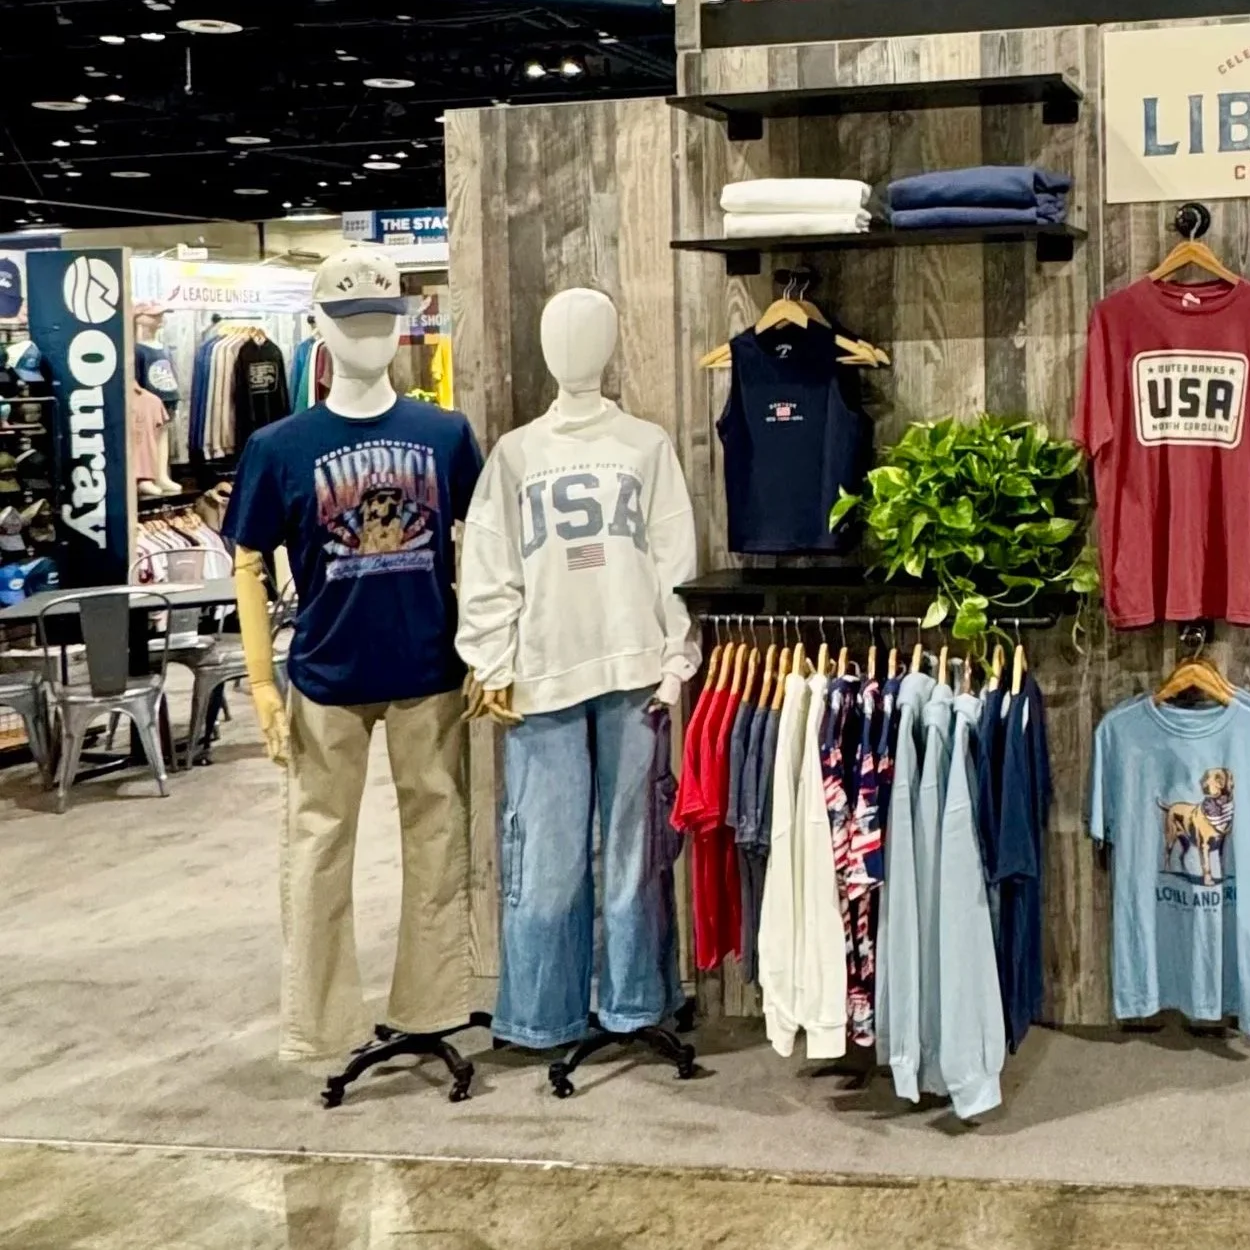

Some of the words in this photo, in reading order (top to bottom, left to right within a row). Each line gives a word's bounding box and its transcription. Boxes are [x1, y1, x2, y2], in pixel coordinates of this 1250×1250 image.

[381, 217, 411, 231] THE
[182, 287, 223, 303] LEAGUE
[225, 288, 261, 304] UNISEX
[1158, 364, 1189, 374] OUTER
[1191, 365, 1226, 375] BANKS
[1147, 377, 1235, 422] USA
[1152, 422, 1180, 431] NORTH
[61, 329, 118, 550] Ouray
[313, 446, 440, 527] AMERICA
[518, 472, 649, 560] USA
[1193, 891, 1221, 907] AND
